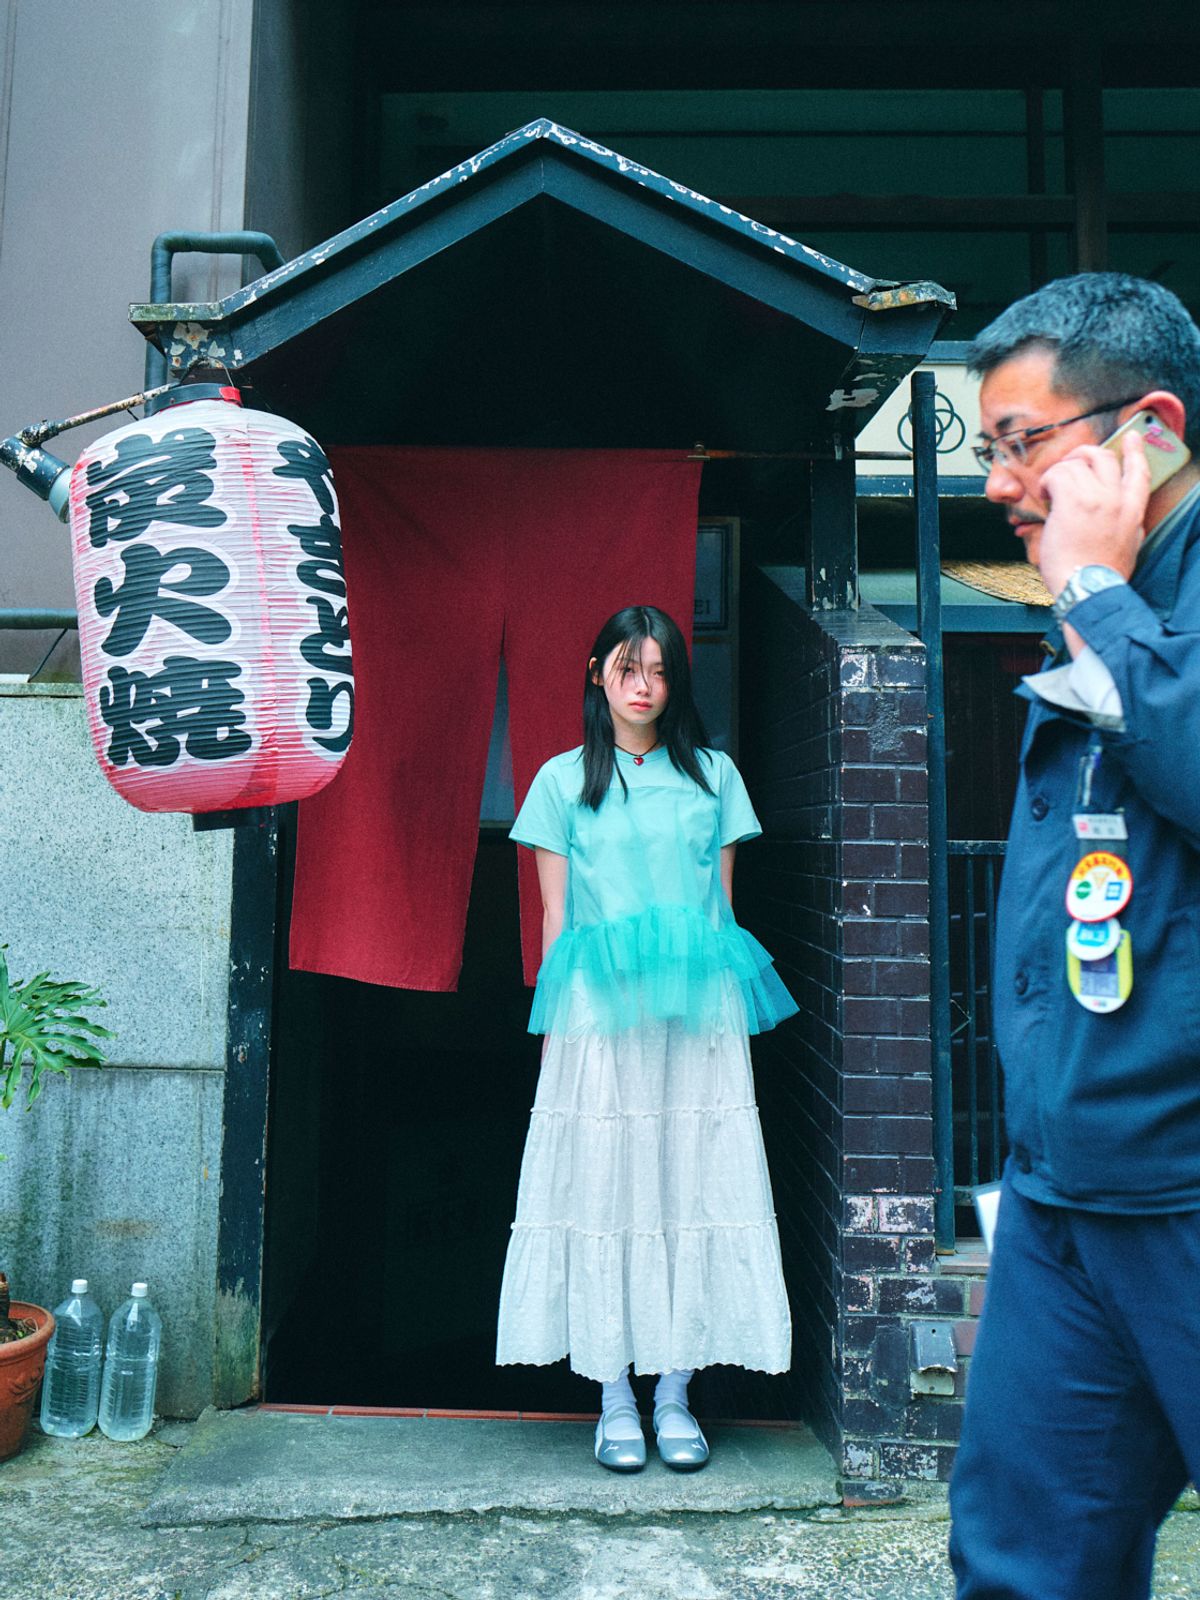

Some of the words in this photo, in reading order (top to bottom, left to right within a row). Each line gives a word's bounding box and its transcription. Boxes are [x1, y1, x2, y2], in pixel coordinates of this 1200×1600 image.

[86, 427, 252, 766] 炭火焼
[273, 437, 354, 752] やきとり
